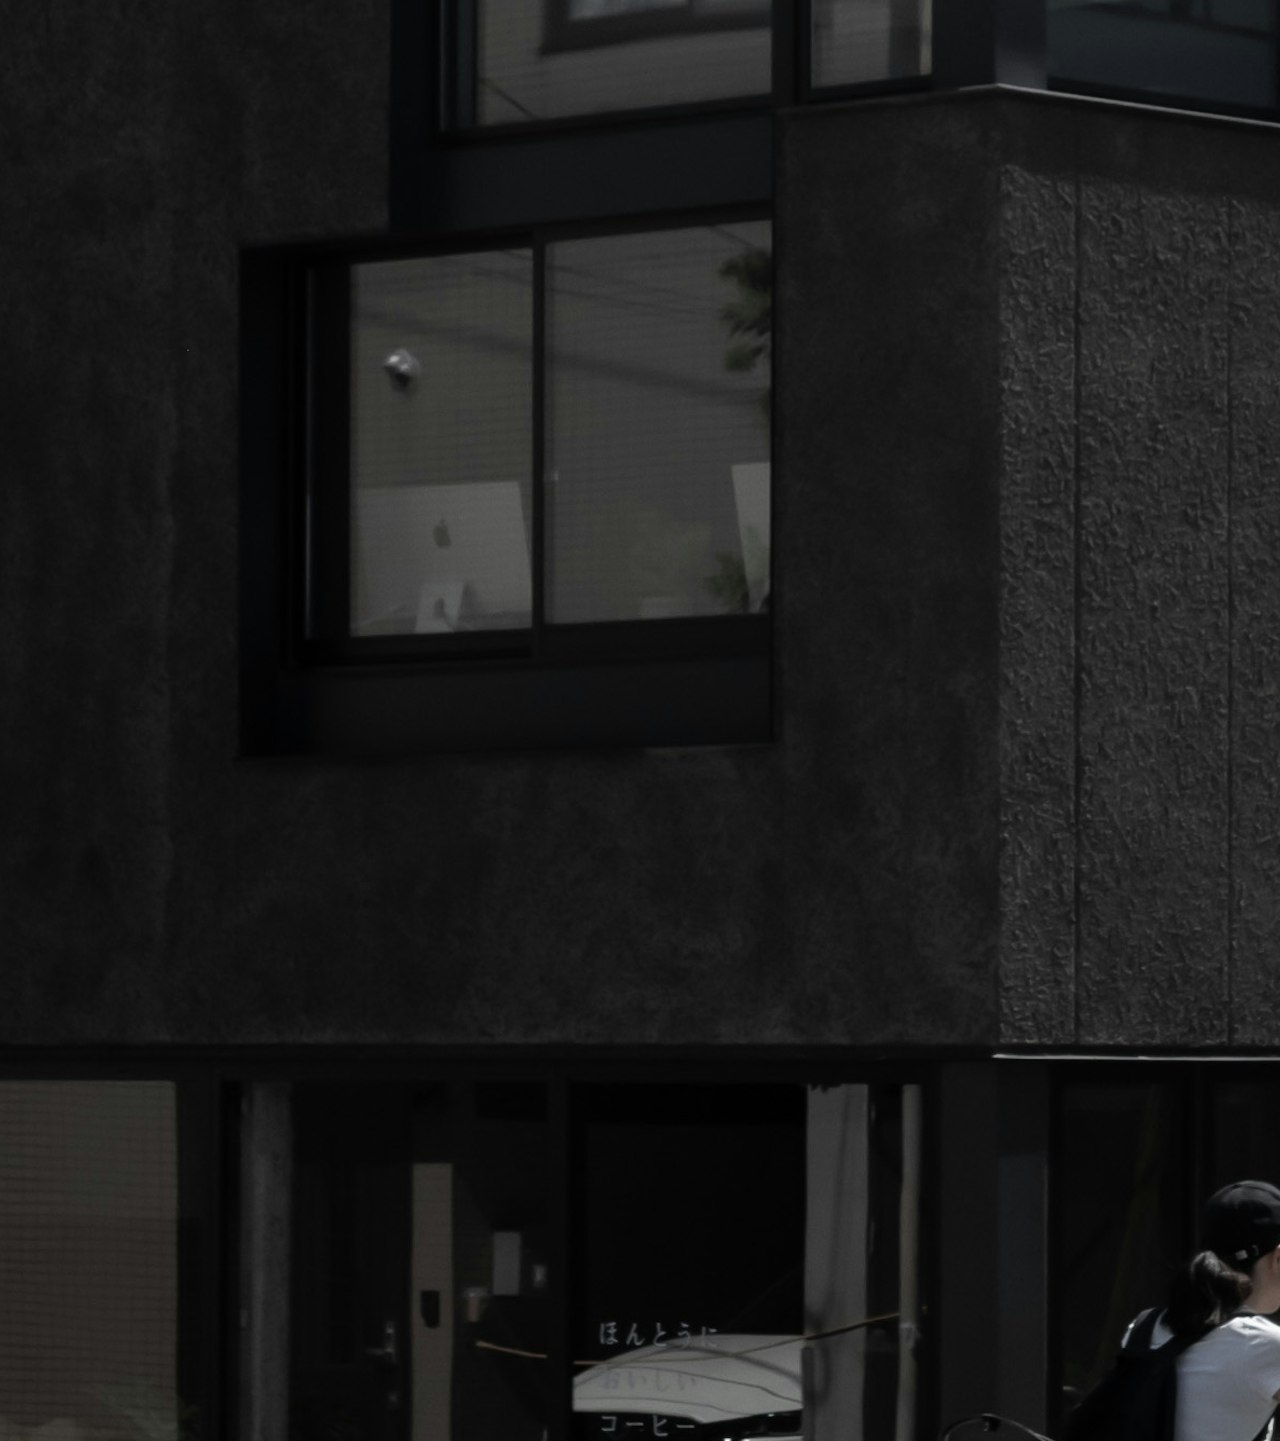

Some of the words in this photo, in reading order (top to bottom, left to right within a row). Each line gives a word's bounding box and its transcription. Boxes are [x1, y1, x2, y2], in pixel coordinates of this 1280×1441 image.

[599, 1322, 718, 1349] ほんとうに
[600, 1415, 696, 1437] コーヒー
